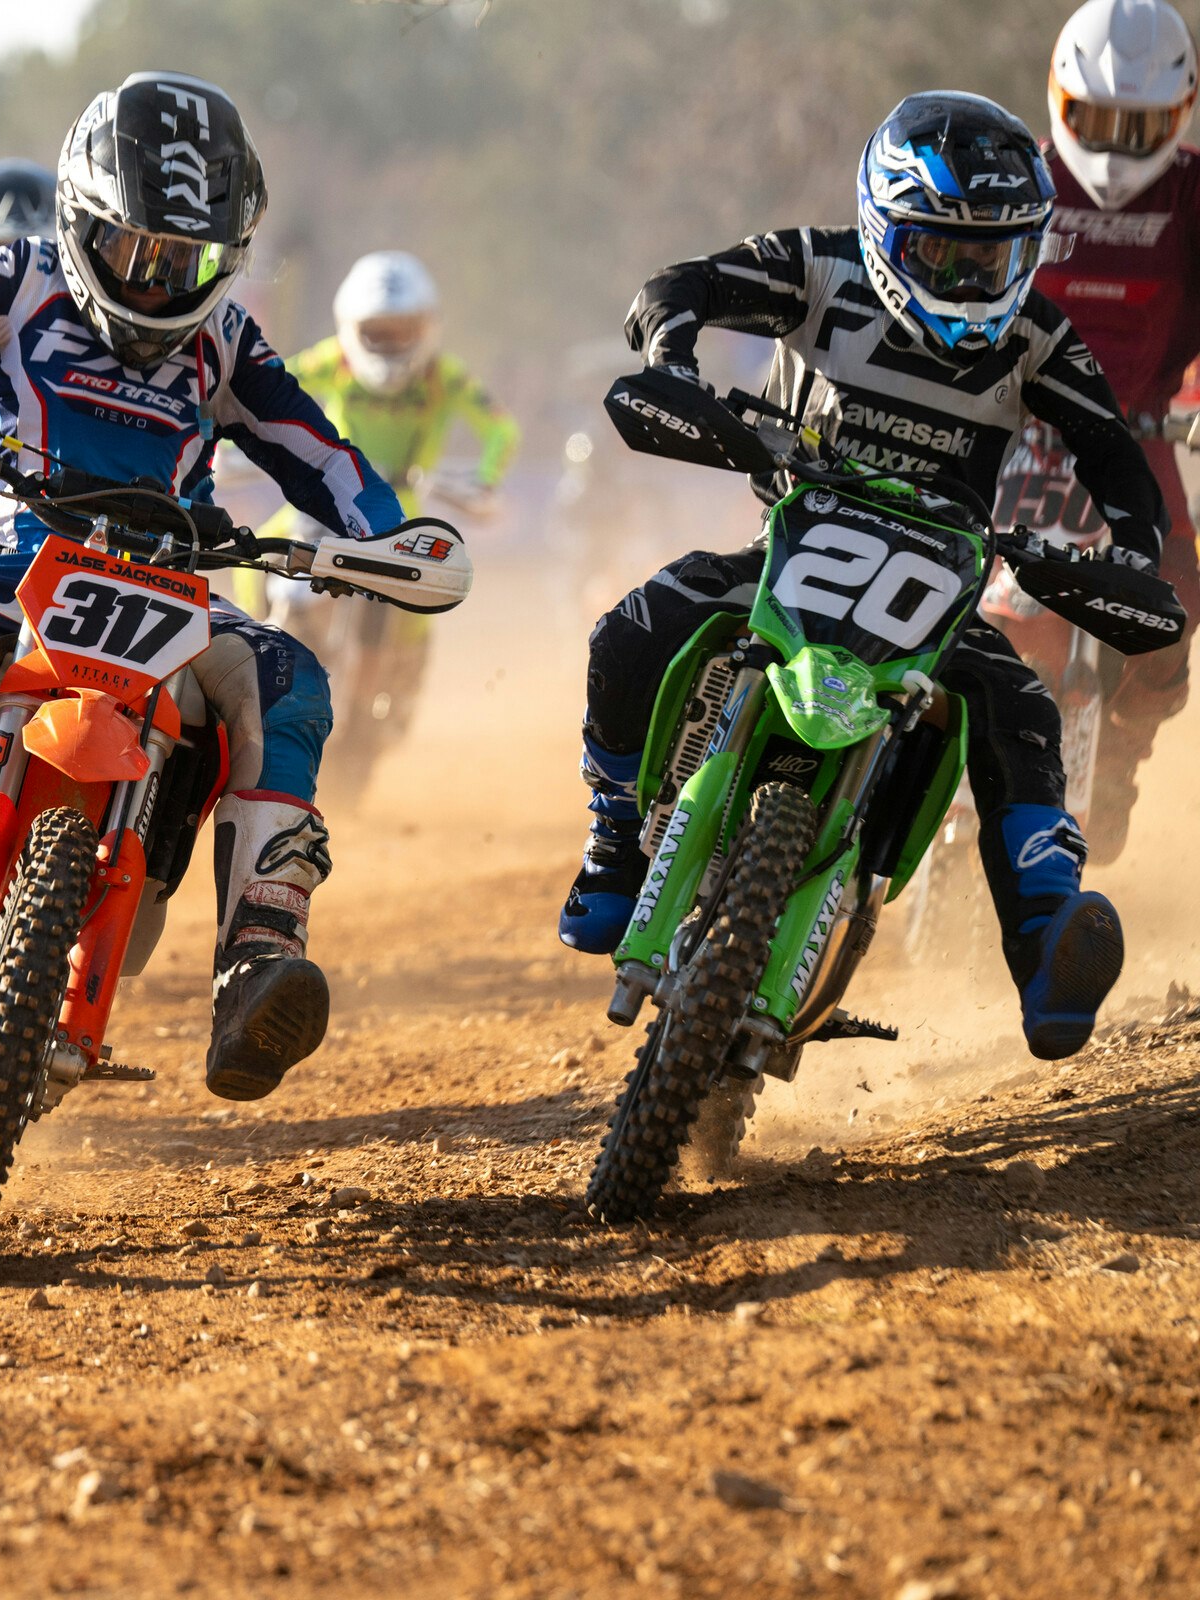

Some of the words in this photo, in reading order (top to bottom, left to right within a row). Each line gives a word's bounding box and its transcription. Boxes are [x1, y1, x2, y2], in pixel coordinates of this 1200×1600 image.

[968, 173, 1029, 190] FLY
[94, 406, 148, 429] REVO
[613, 391, 701, 440] ACERBIS
[837, 507, 948, 551] CAPLINGER
[55, 551, 106, 572] JASE
[109, 564, 196, 600] JACKSON
[771, 522, 963, 651] 20
[44, 579, 194, 665] 317
[1085, 597, 1179, 632] ACERBIS
[71, 664, 131, 688] ATTACK
[633, 808, 692, 924] MAXXIS
[790, 876, 844, 1001] MAXXIS
